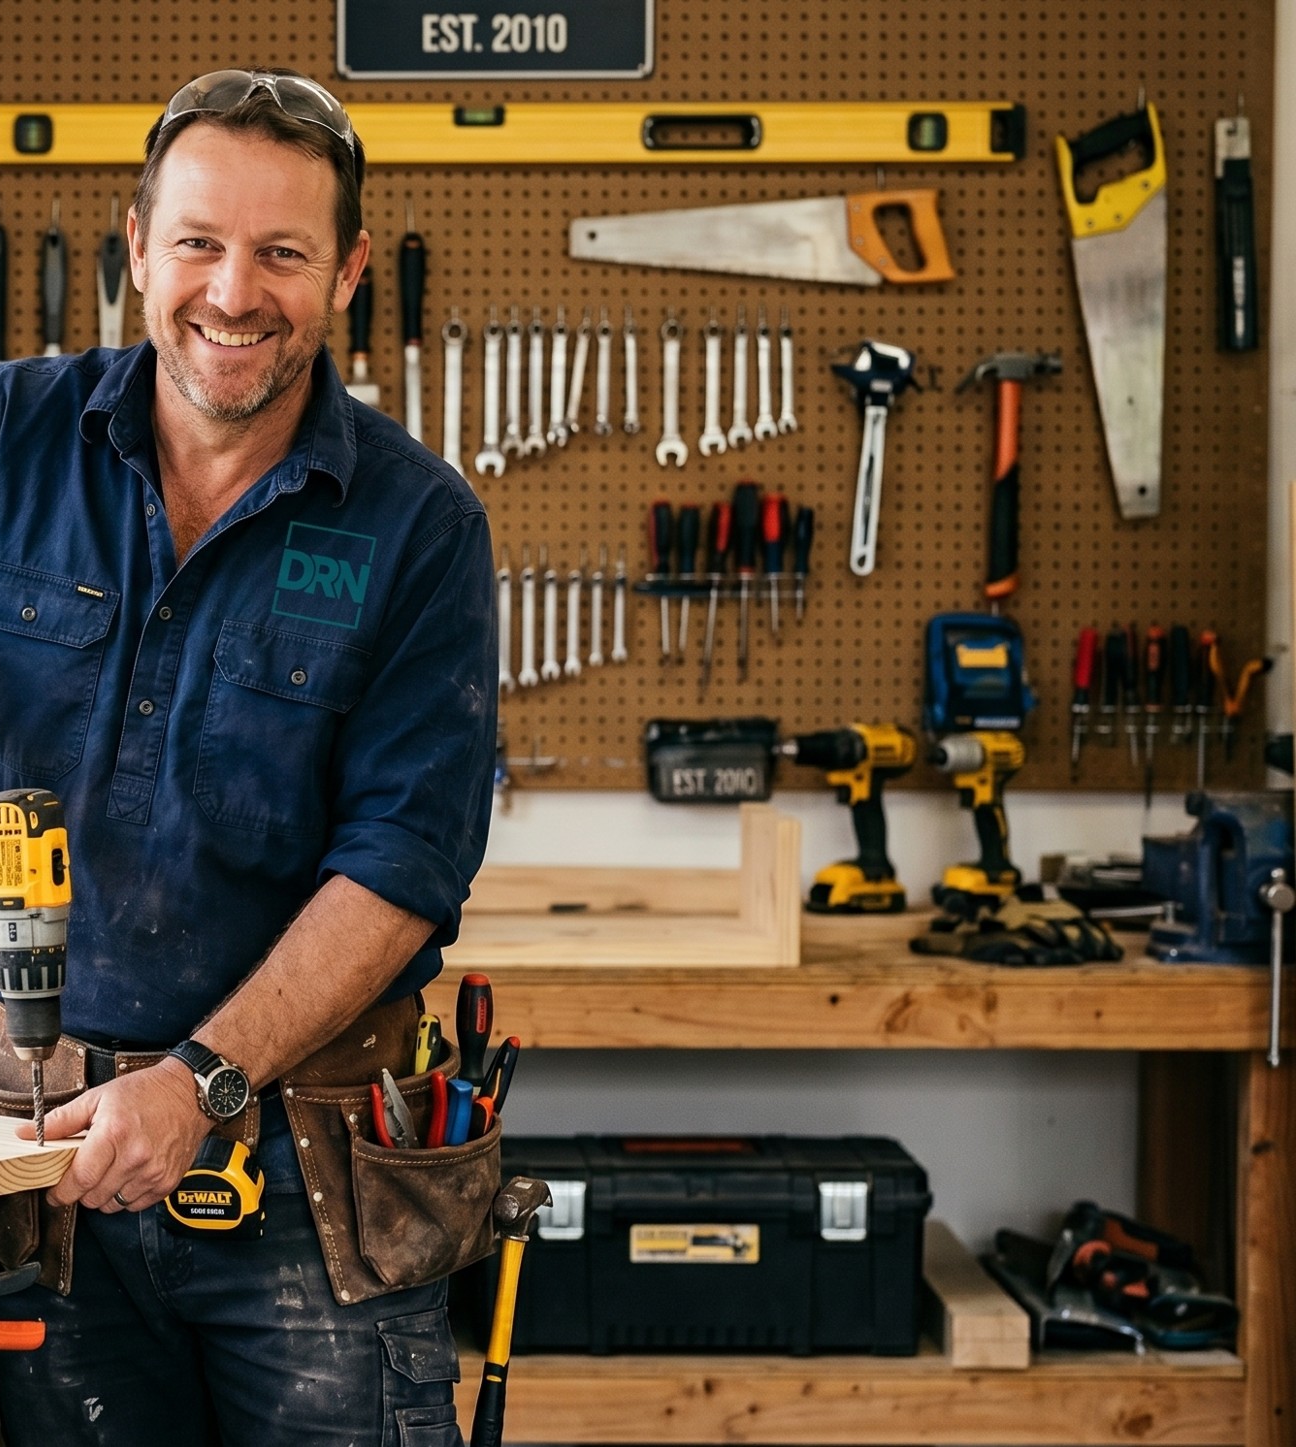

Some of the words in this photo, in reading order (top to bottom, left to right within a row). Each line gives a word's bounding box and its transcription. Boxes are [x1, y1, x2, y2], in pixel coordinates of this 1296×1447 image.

[422, 13, 484, 53] EST.
[491, 13, 568, 53] 2010
[276, 547, 372, 605] DRN
